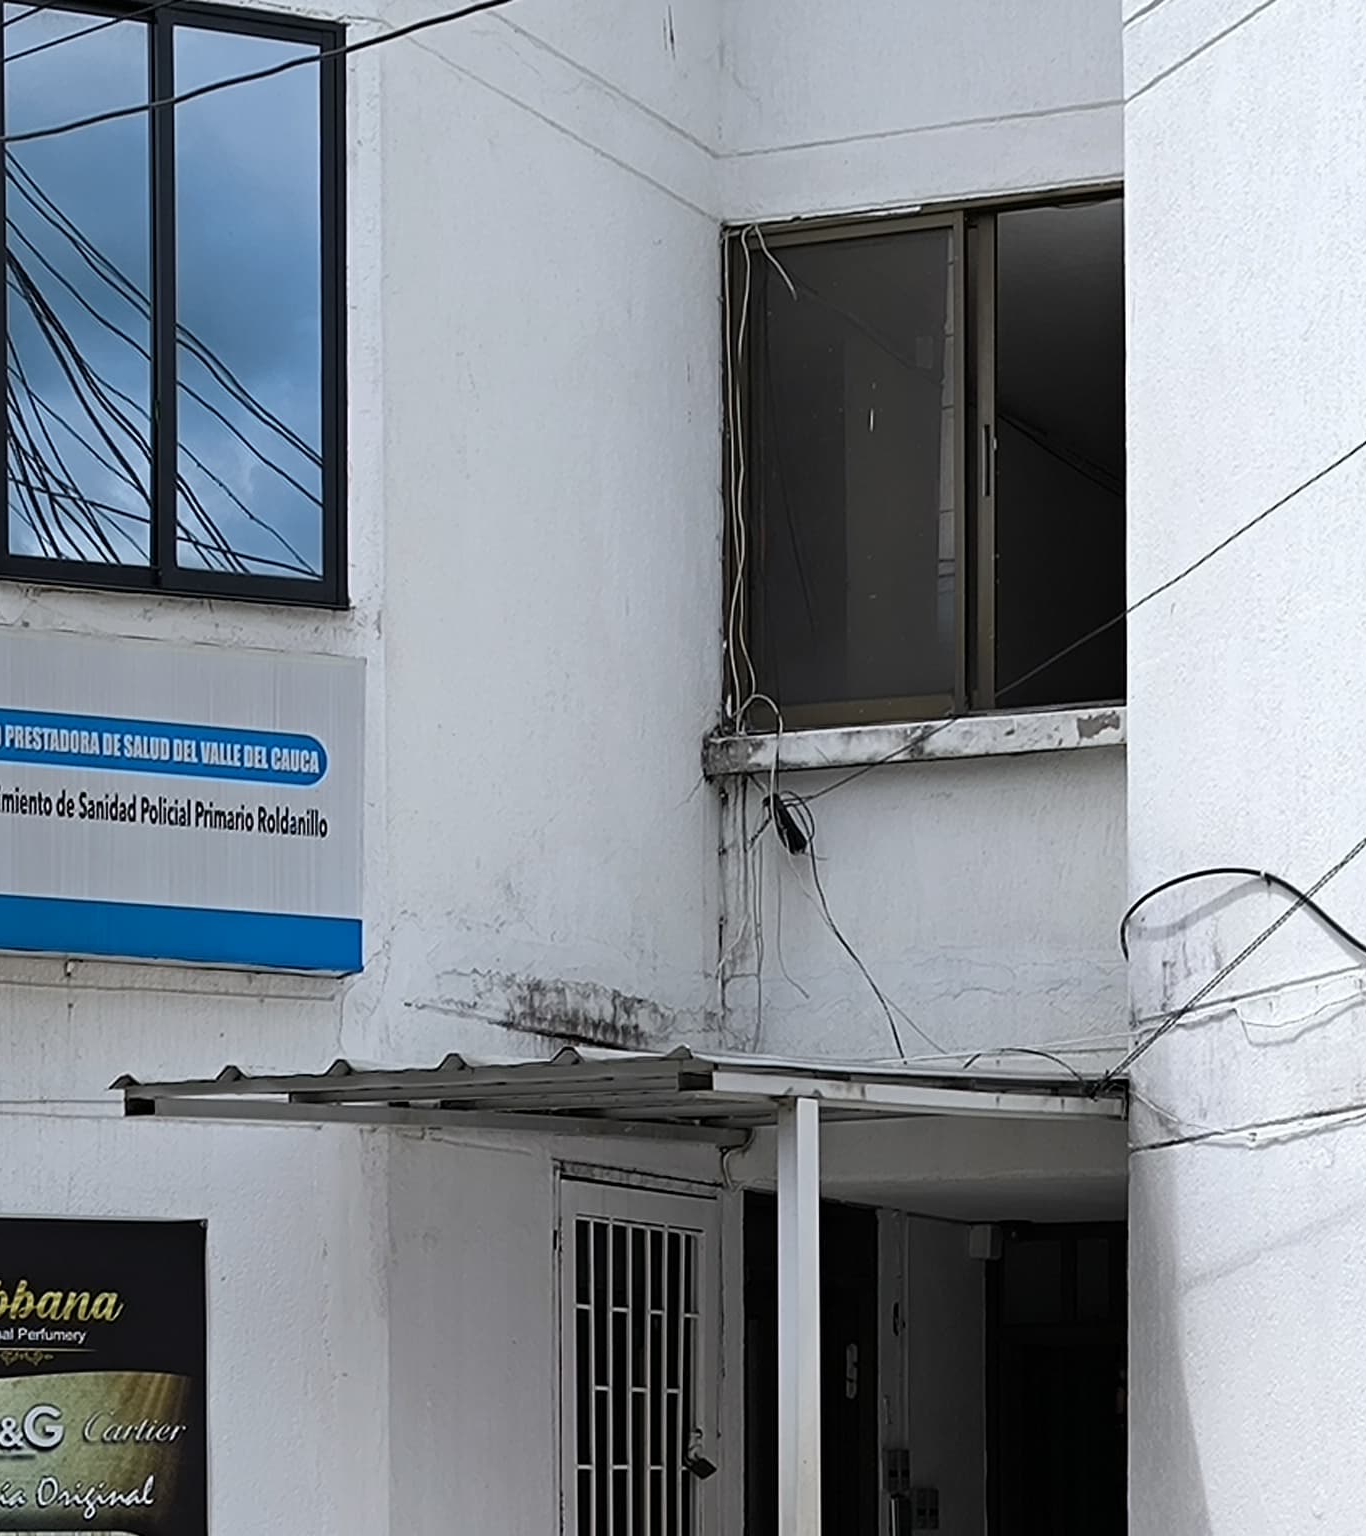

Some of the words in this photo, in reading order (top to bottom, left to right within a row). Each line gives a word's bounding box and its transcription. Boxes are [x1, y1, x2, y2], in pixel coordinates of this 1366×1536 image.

[4, 724, 100, 755] PRESTADORA
[103, 732, 122, 758] DE
[124, 733, 170, 761] SALUD
[172, 738, 199, 764] DEL
[200, 741, 241, 767] VALLE
[243, 745, 269, 770] DEL
[270, 747, 320, 774] CAUCA
[56, 788, 75, 819] de
[78, 791, 136, 823] Sanidad
[140, 796, 192, 827] Policial
[195, 800, 254, 832] Primario
[257, 806, 328, 838] Roldanillo
[17, 1327, 87, 1344] Perfumery
[83, 1411, 188, 1446] Cartier
[38, 1474, 155, 1519] Original
